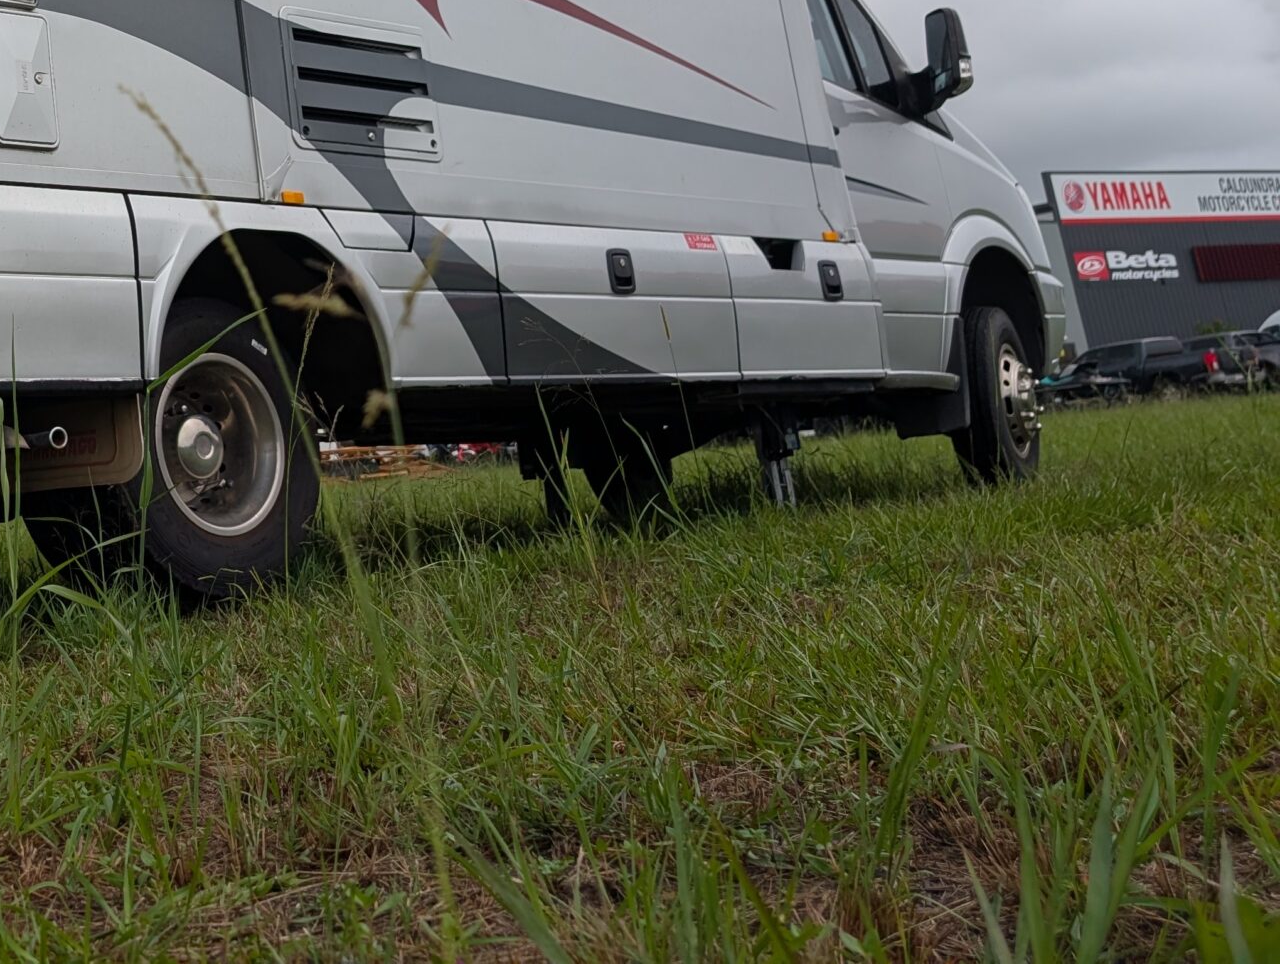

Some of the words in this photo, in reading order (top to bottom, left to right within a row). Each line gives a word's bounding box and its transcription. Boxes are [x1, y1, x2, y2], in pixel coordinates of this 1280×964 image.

[1218, 177, 1280, 193] CALOUNDRA
[1085, 181, 1171, 211] YAMAHA
[1197, 195, 1272, 213] MOTORCYCLE
[1105, 249, 1177, 269] Beta
[1111, 267, 1179, 282] motorcycles
